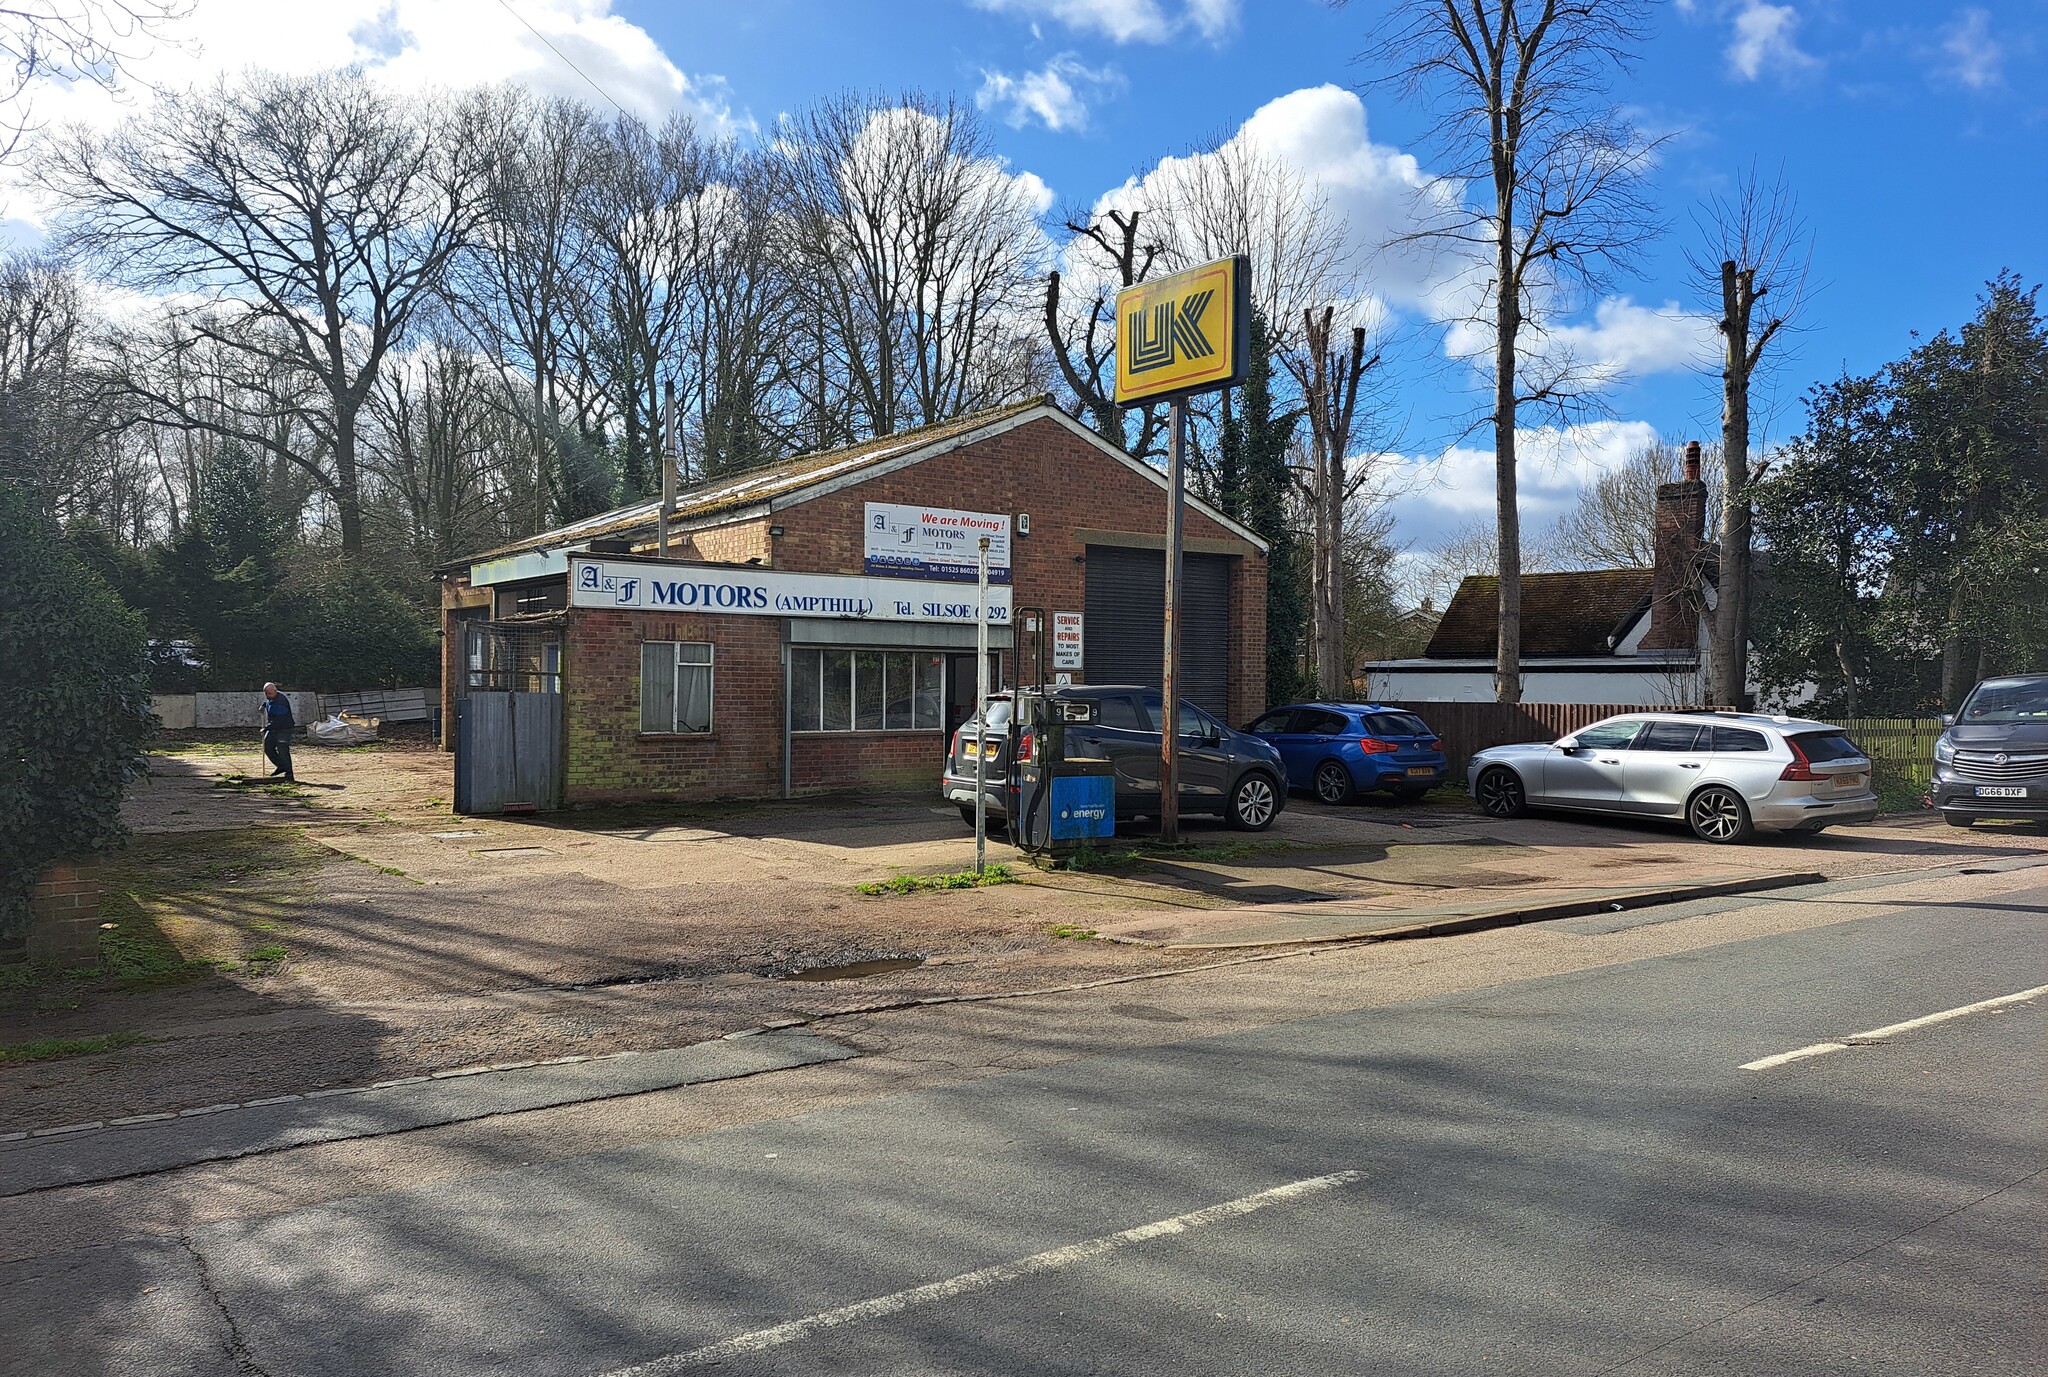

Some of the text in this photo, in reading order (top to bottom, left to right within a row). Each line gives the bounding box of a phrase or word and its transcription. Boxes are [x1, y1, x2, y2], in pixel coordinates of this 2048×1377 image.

[1128, 288, 1215, 375] UK
[873, 514, 885, 530] A
[890, 524, 896, 532] &
[921, 513, 937, 524] We
[939, 517, 957, 525] are
[960, 516, 999, 531] Moving
[922, 527, 965, 539] MOTORS
[935, 541, 951, 550] LTD
[941, 565, 958, 573] 01525
[581, 566, 600, 591] A
[604, 579, 615, 591] &
[651, 581, 768, 609] MOTORS
[775, 591, 874, 615] (AMPTHILL)
[893, 600, 916, 616] Tel.
[922, 603, 971, 618] SILSOE
[1057, 616, 1080, 625] SERVICE
[1057, 632, 1080, 641] REPAIRS
[1056, 708, 1062, 716] 9
[1092, 708, 1098, 717] 9
[1979, 788, 2023, 796] DG66 DXF
[1073, 809, 1105, 820] energy
